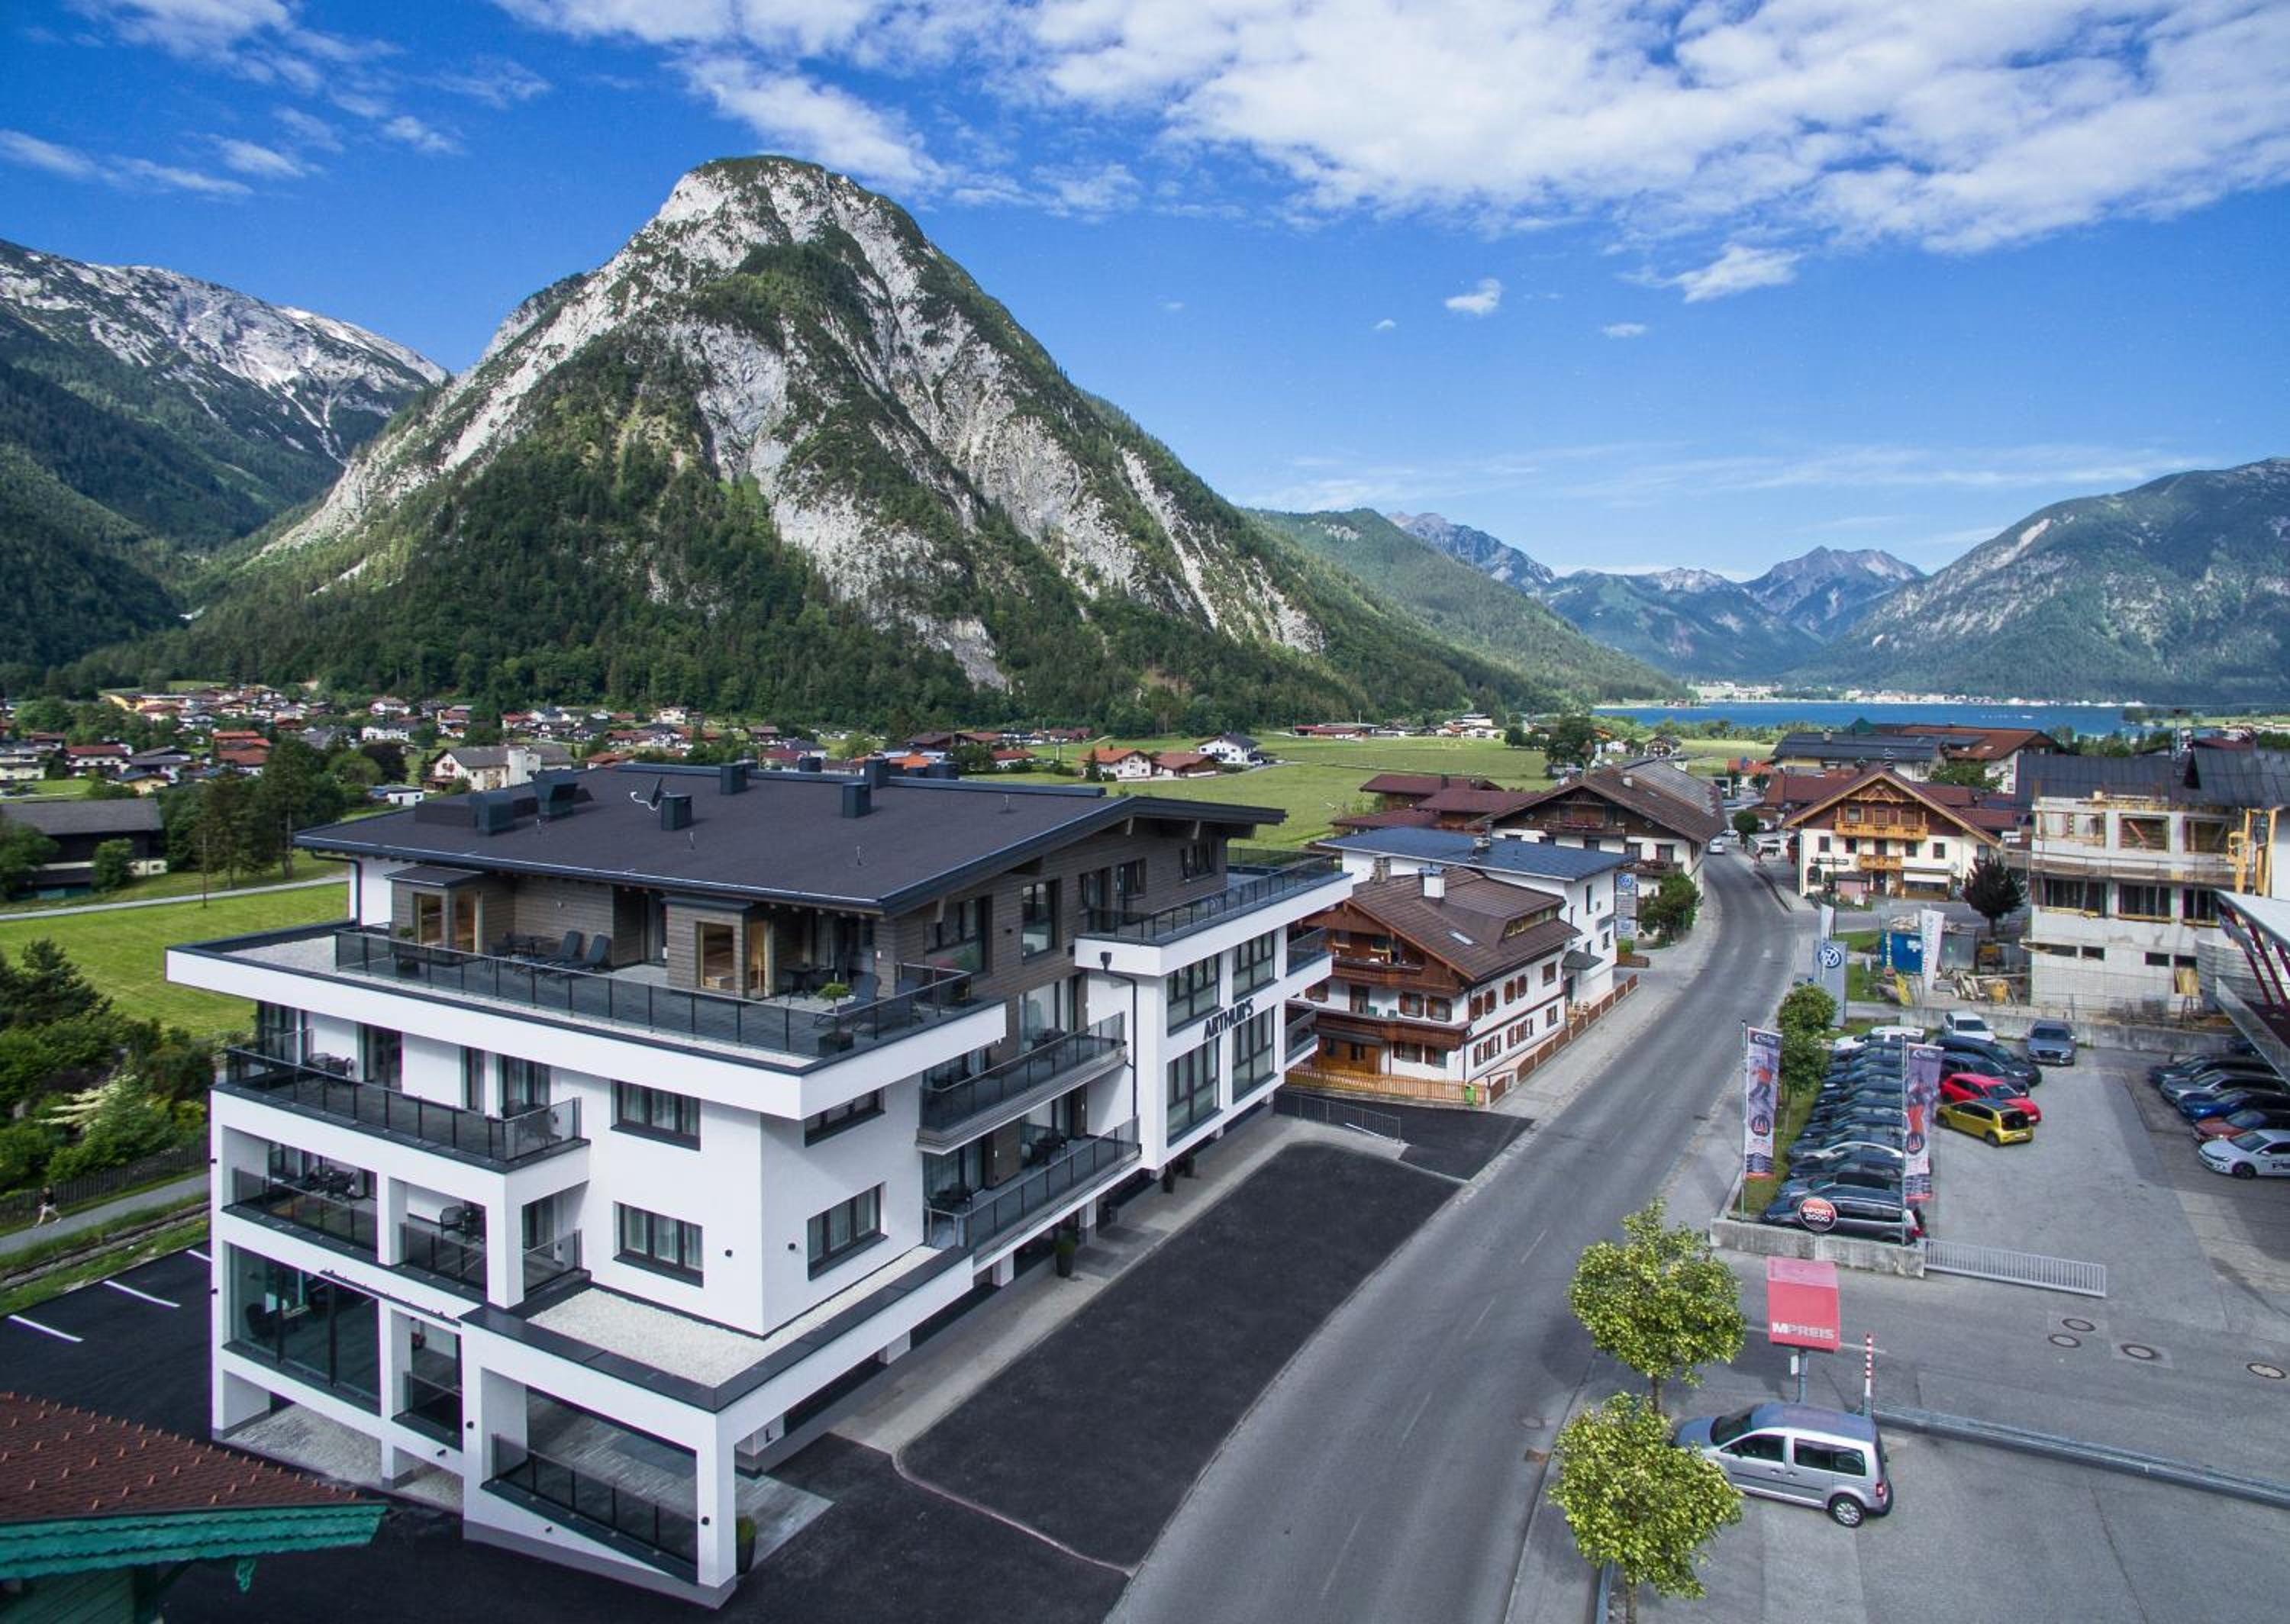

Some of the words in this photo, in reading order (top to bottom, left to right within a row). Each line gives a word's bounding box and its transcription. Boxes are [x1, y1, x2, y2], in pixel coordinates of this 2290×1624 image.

[1203, 997, 1253, 1041] ARTHUR'S
[1802, 1207, 1832, 1217] SPORT
[1805, 1213, 1830, 1222] 2000
[1772, 1321, 1834, 1339] MPREIS
